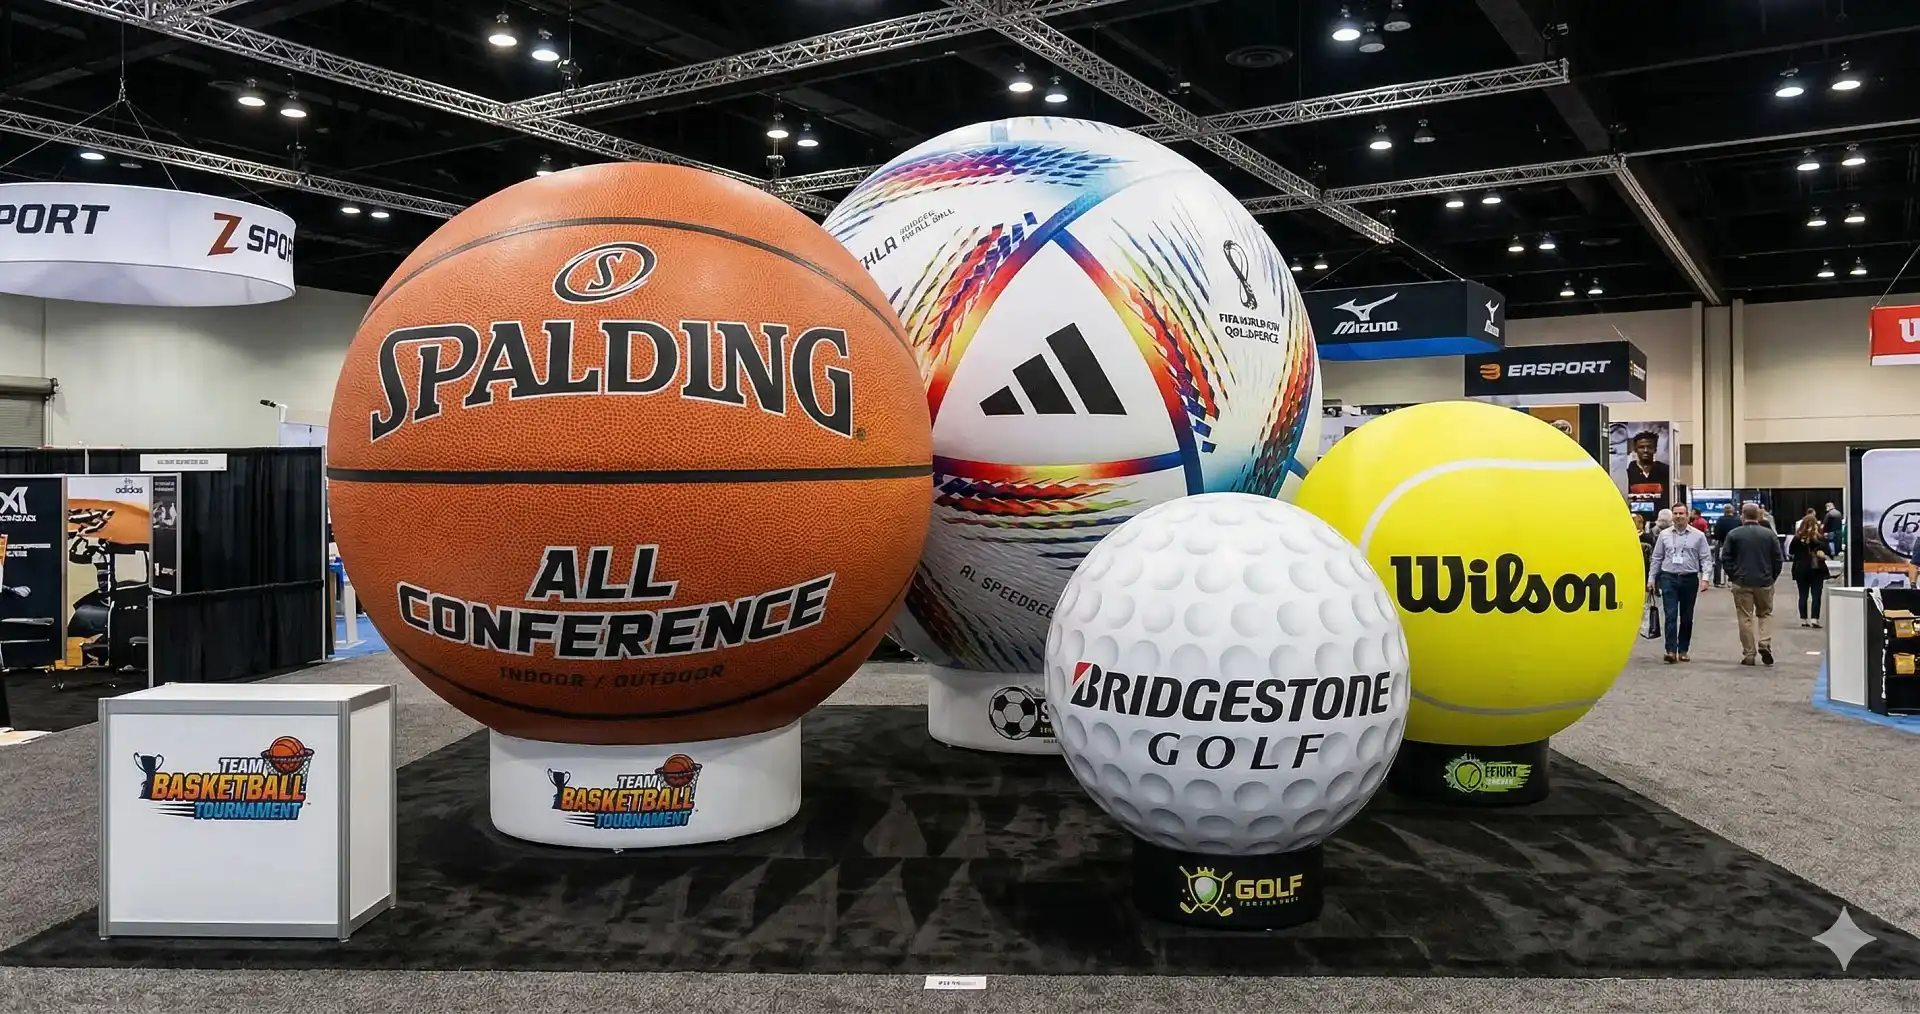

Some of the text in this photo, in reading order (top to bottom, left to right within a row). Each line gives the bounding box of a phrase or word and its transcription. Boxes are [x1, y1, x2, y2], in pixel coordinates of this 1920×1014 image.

[207, 212, 242, 257] Z
[1332, 320, 1399, 336] MIZUNO
[370, 319, 854, 443] SPALDING
[115, 485, 144, 495] adidas
[524, 544, 679, 603] ALL
[1389, 552, 1619, 615] Wilson
[396, 572, 837, 660] CONFERENCE
[499, 666, 585, 688] INDOOR
[614, 664, 725, 688] OUTDOOR
[1070, 661, 1391, 724] BRIDGESTONE
[1148, 732, 1325, 770] GOLF
[218, 757, 265, 774] TEAM
[151, 772, 305, 801] BASKETBALL
[617, 774, 660, 789] TEAM
[194, 801, 302, 820] TOURNAMENT
[561, 786, 695, 812] BASKETBALL
[595, 810, 692, 829] TOURNAMENT
[1235, 873, 1304, 900] GOLF
